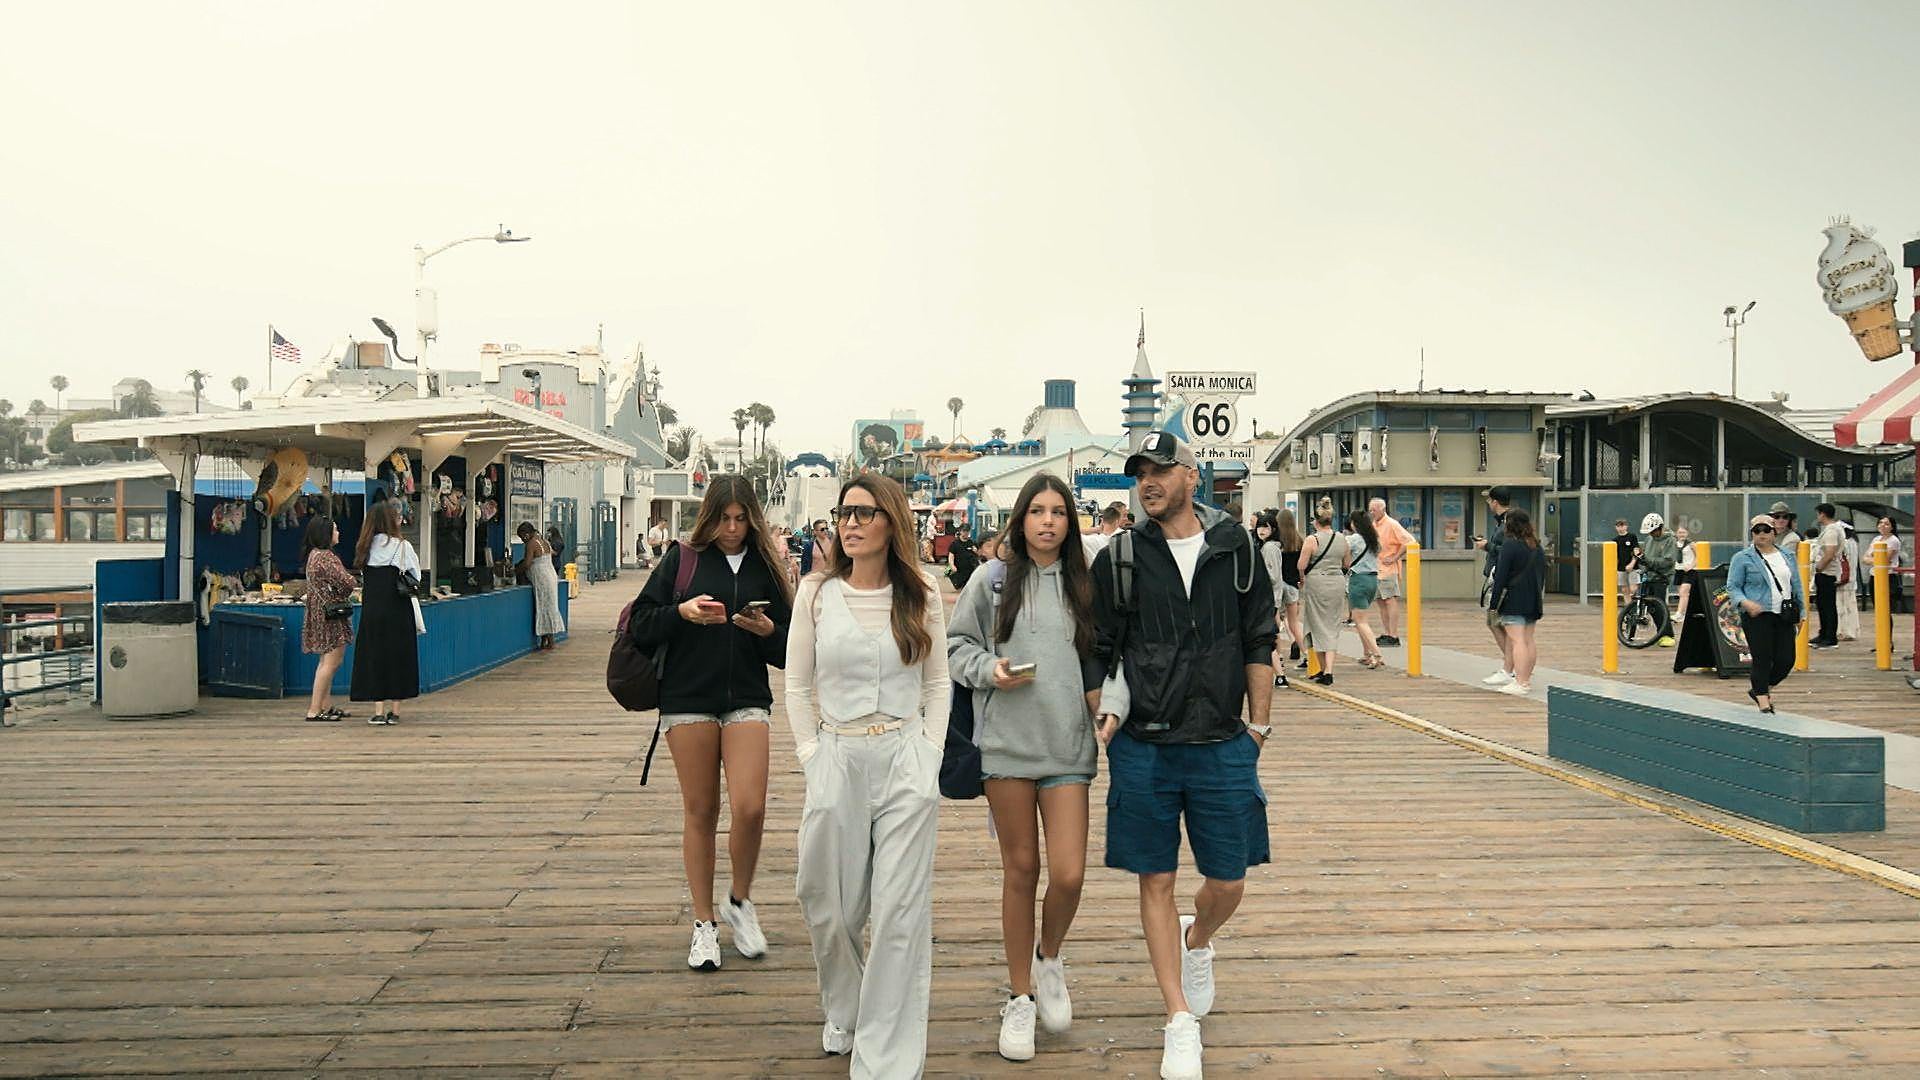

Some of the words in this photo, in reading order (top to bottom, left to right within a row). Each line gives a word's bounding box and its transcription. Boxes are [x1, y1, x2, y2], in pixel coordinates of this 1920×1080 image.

[1170, 375, 1205, 388] SANTA
[1209, 377, 1253, 390] MONICA
[1193, 403, 1230, 437] 66
[1194, 447, 1205, 458] of
[1209, 447, 1225, 458] the
[1230, 447, 1251, 458] Trail
